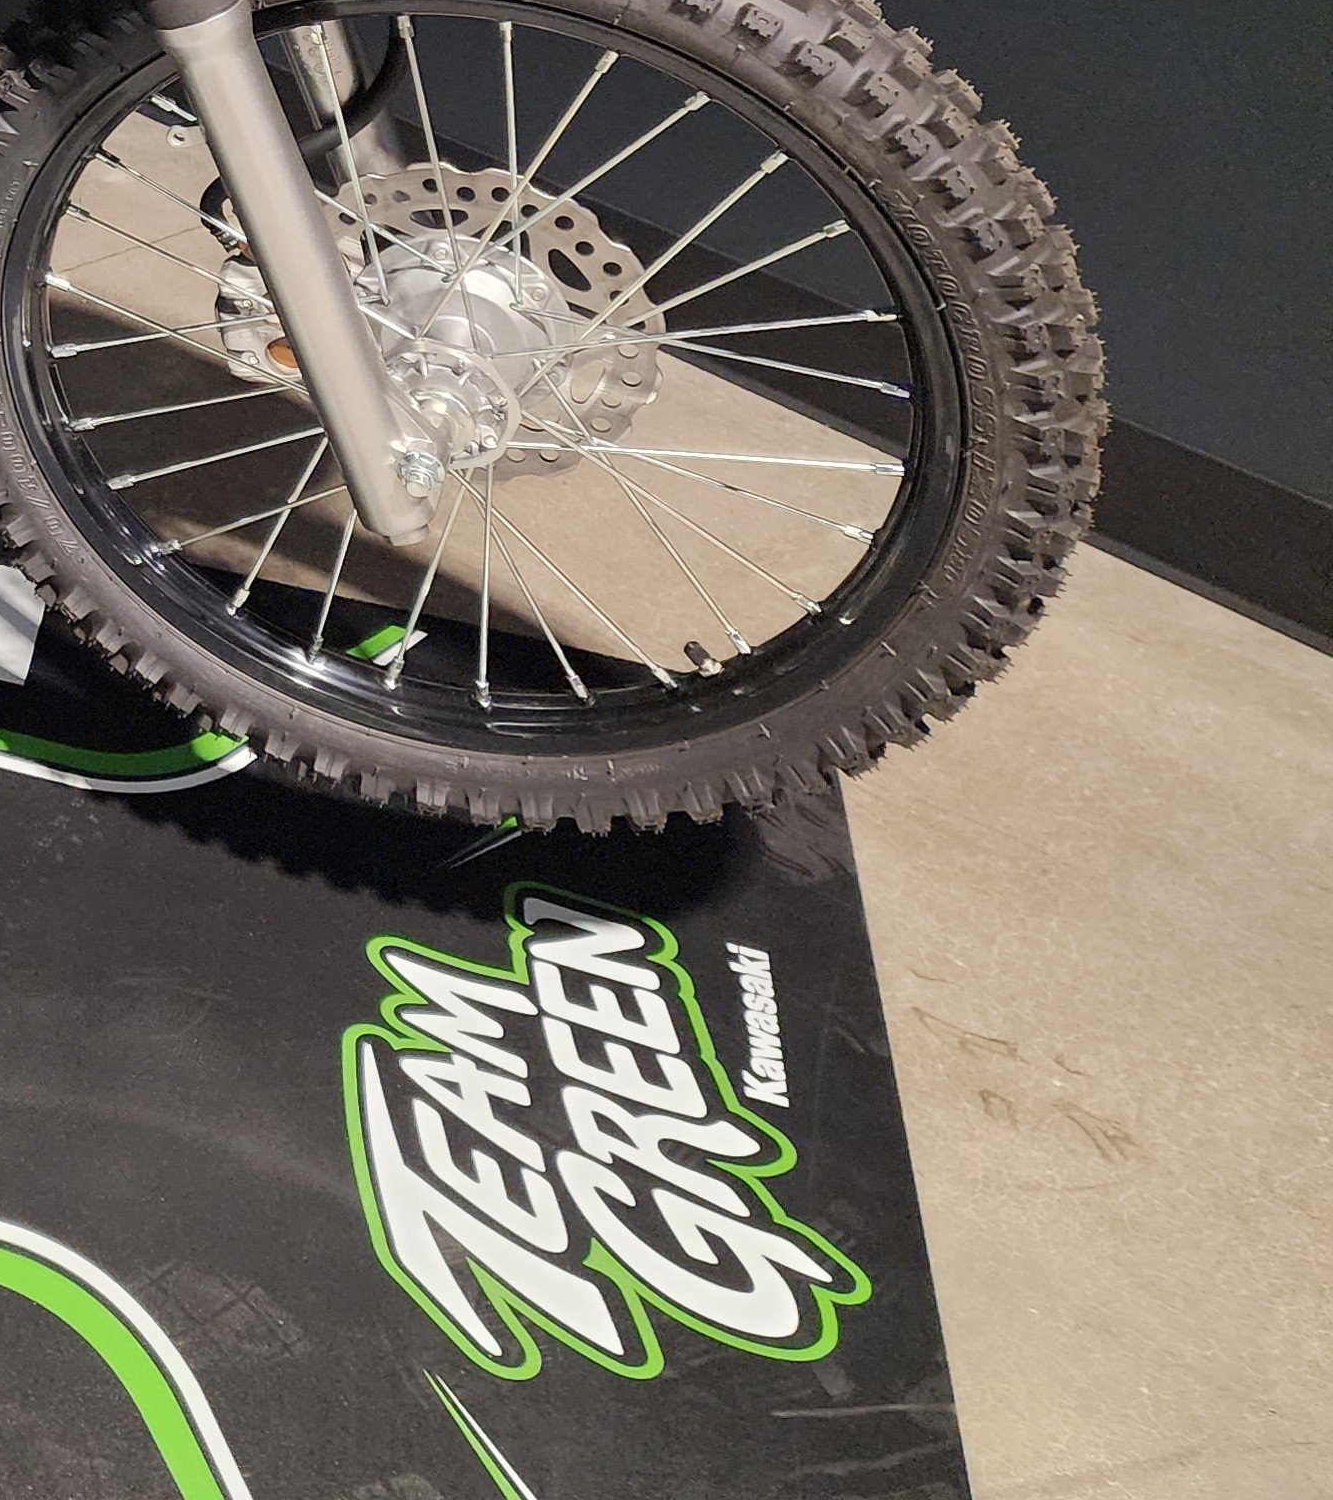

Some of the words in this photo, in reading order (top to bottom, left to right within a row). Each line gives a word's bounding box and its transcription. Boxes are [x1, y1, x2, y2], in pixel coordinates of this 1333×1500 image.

[363, 952, 625, 1356] TEAM
[523, 897, 833, 1338] GREEN
[724, 942, 791, 1108] Kawasaki
